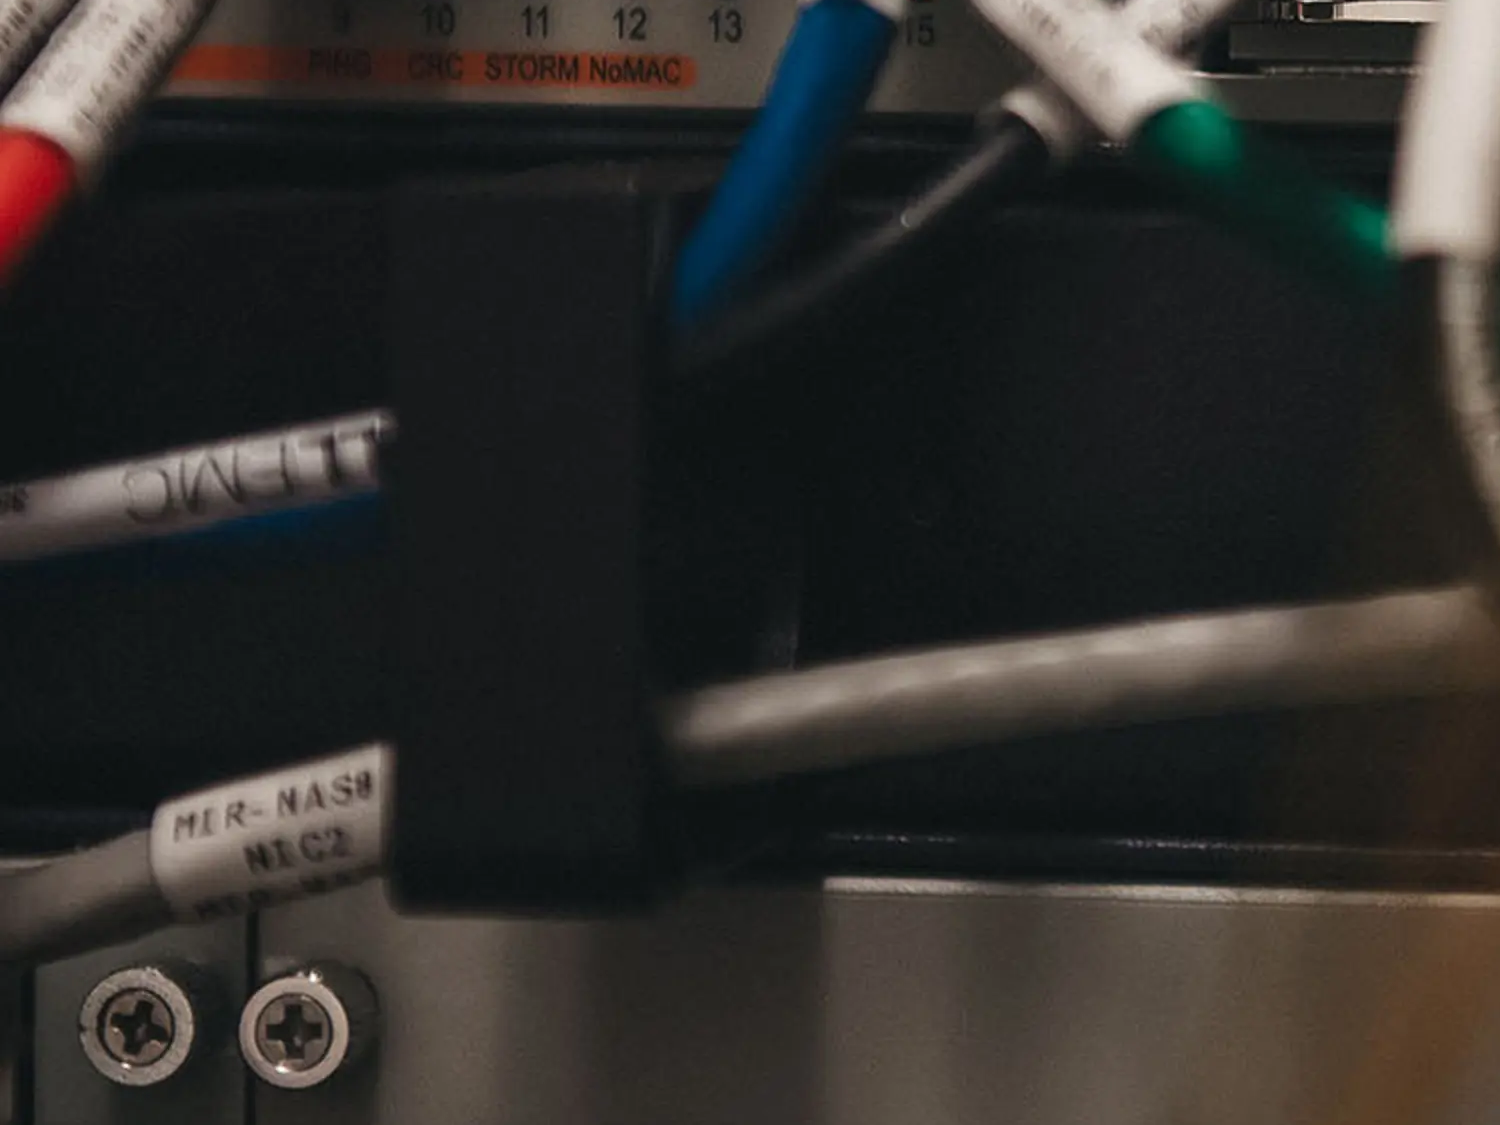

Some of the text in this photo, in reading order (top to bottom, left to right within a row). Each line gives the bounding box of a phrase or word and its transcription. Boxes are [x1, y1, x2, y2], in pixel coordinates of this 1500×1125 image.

[420, 3, 455, 35] 10
[521, 6, 549, 38] 11
[612, 8, 648, 40] 12
[708, 9, 743, 42] 13
[905, 16, 935, 47] 15
[485, 55, 578, 81] STORM
[589, 58, 682, 84] NoMAC
